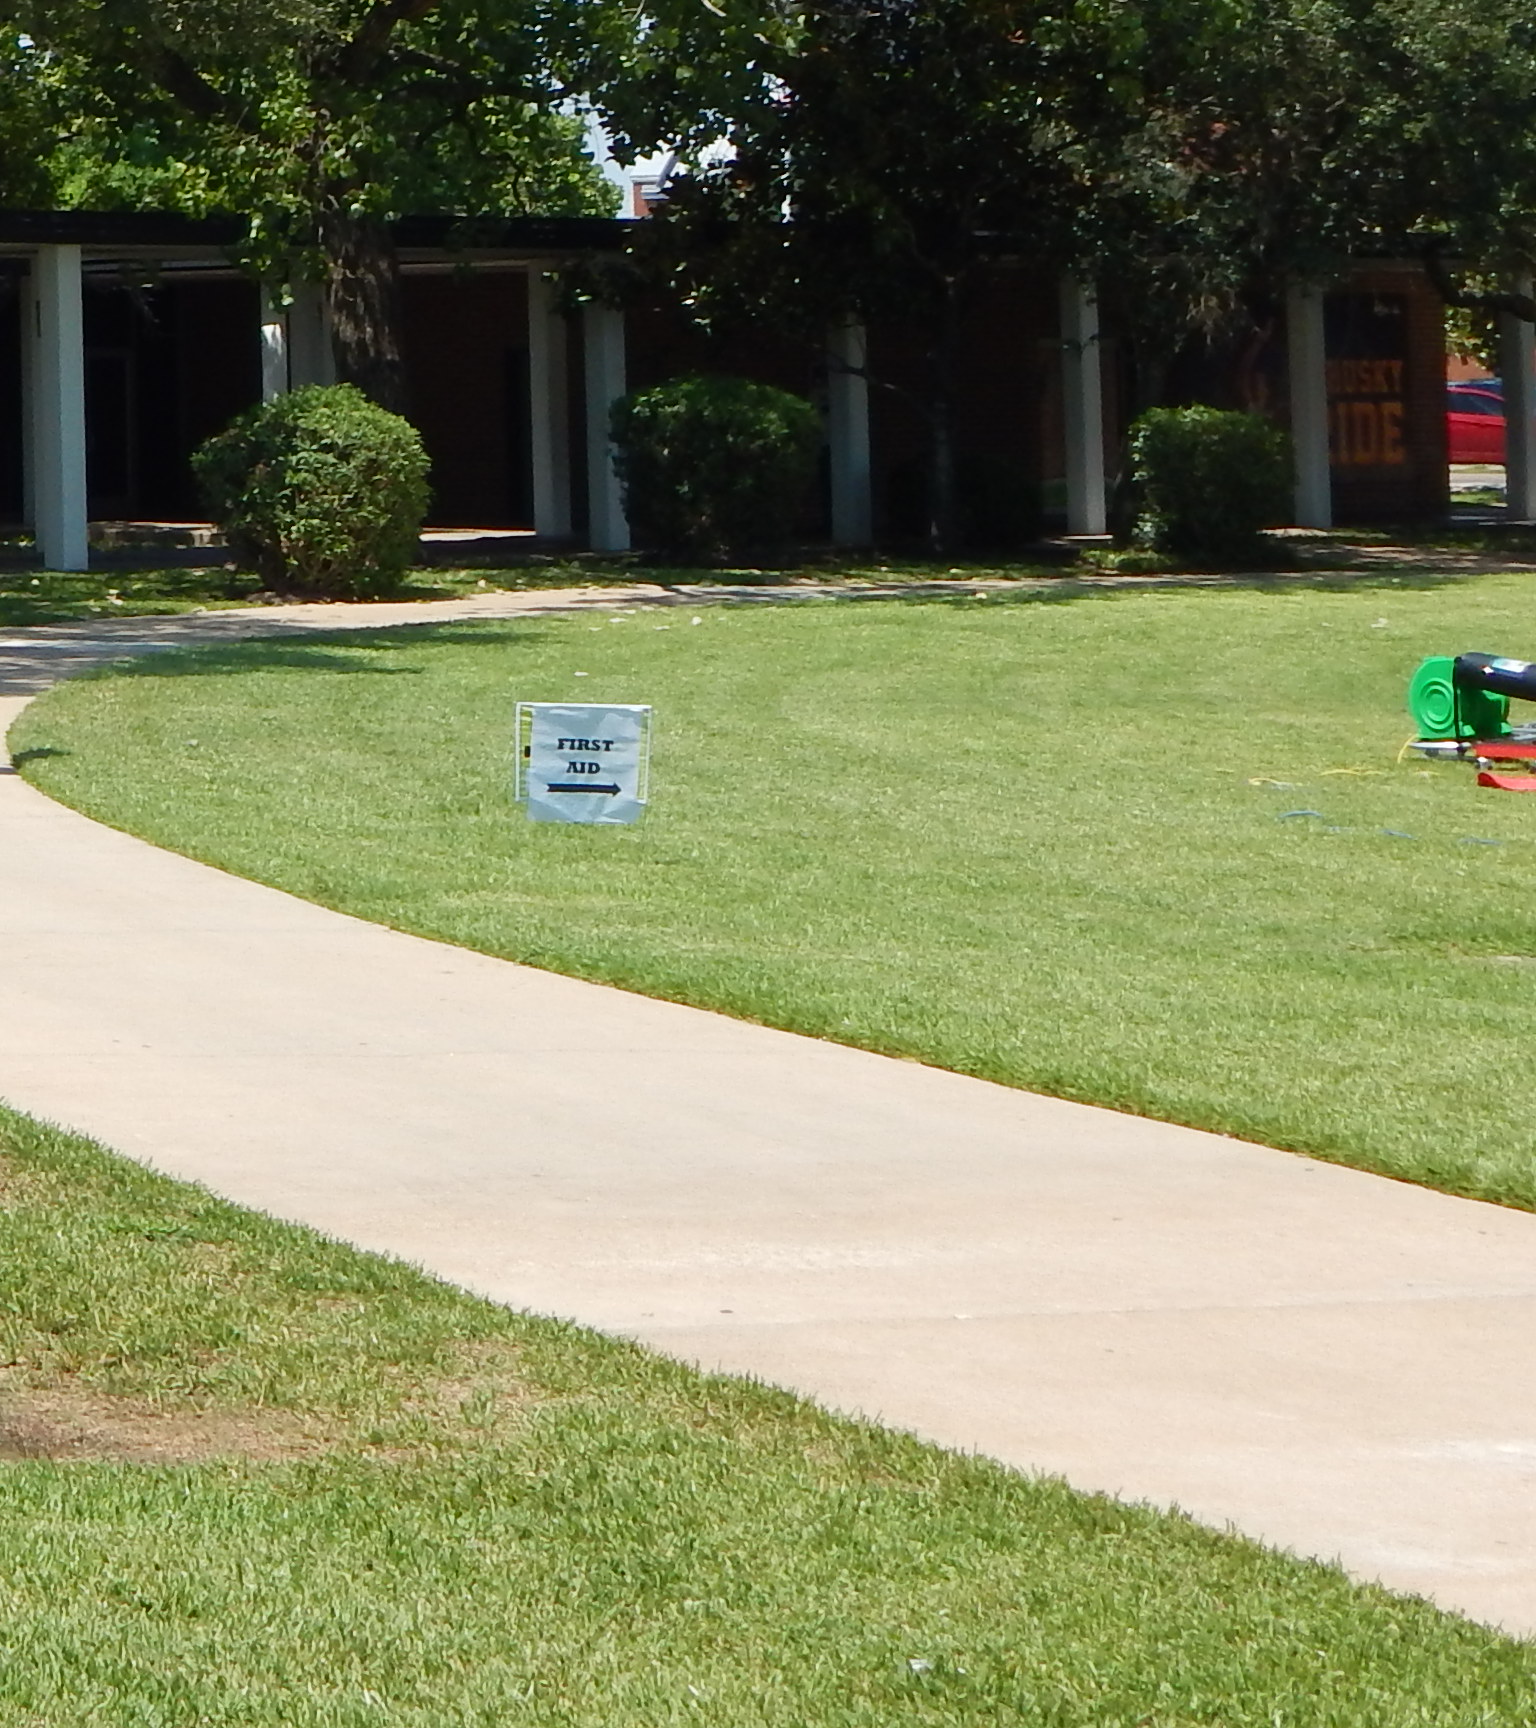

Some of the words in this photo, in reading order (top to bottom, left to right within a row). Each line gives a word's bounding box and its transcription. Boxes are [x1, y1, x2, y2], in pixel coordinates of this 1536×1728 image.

[1327, 401, 1404, 465] IDE
[557, 738, 614, 751] FIRST
[566, 761, 601, 774] AID
